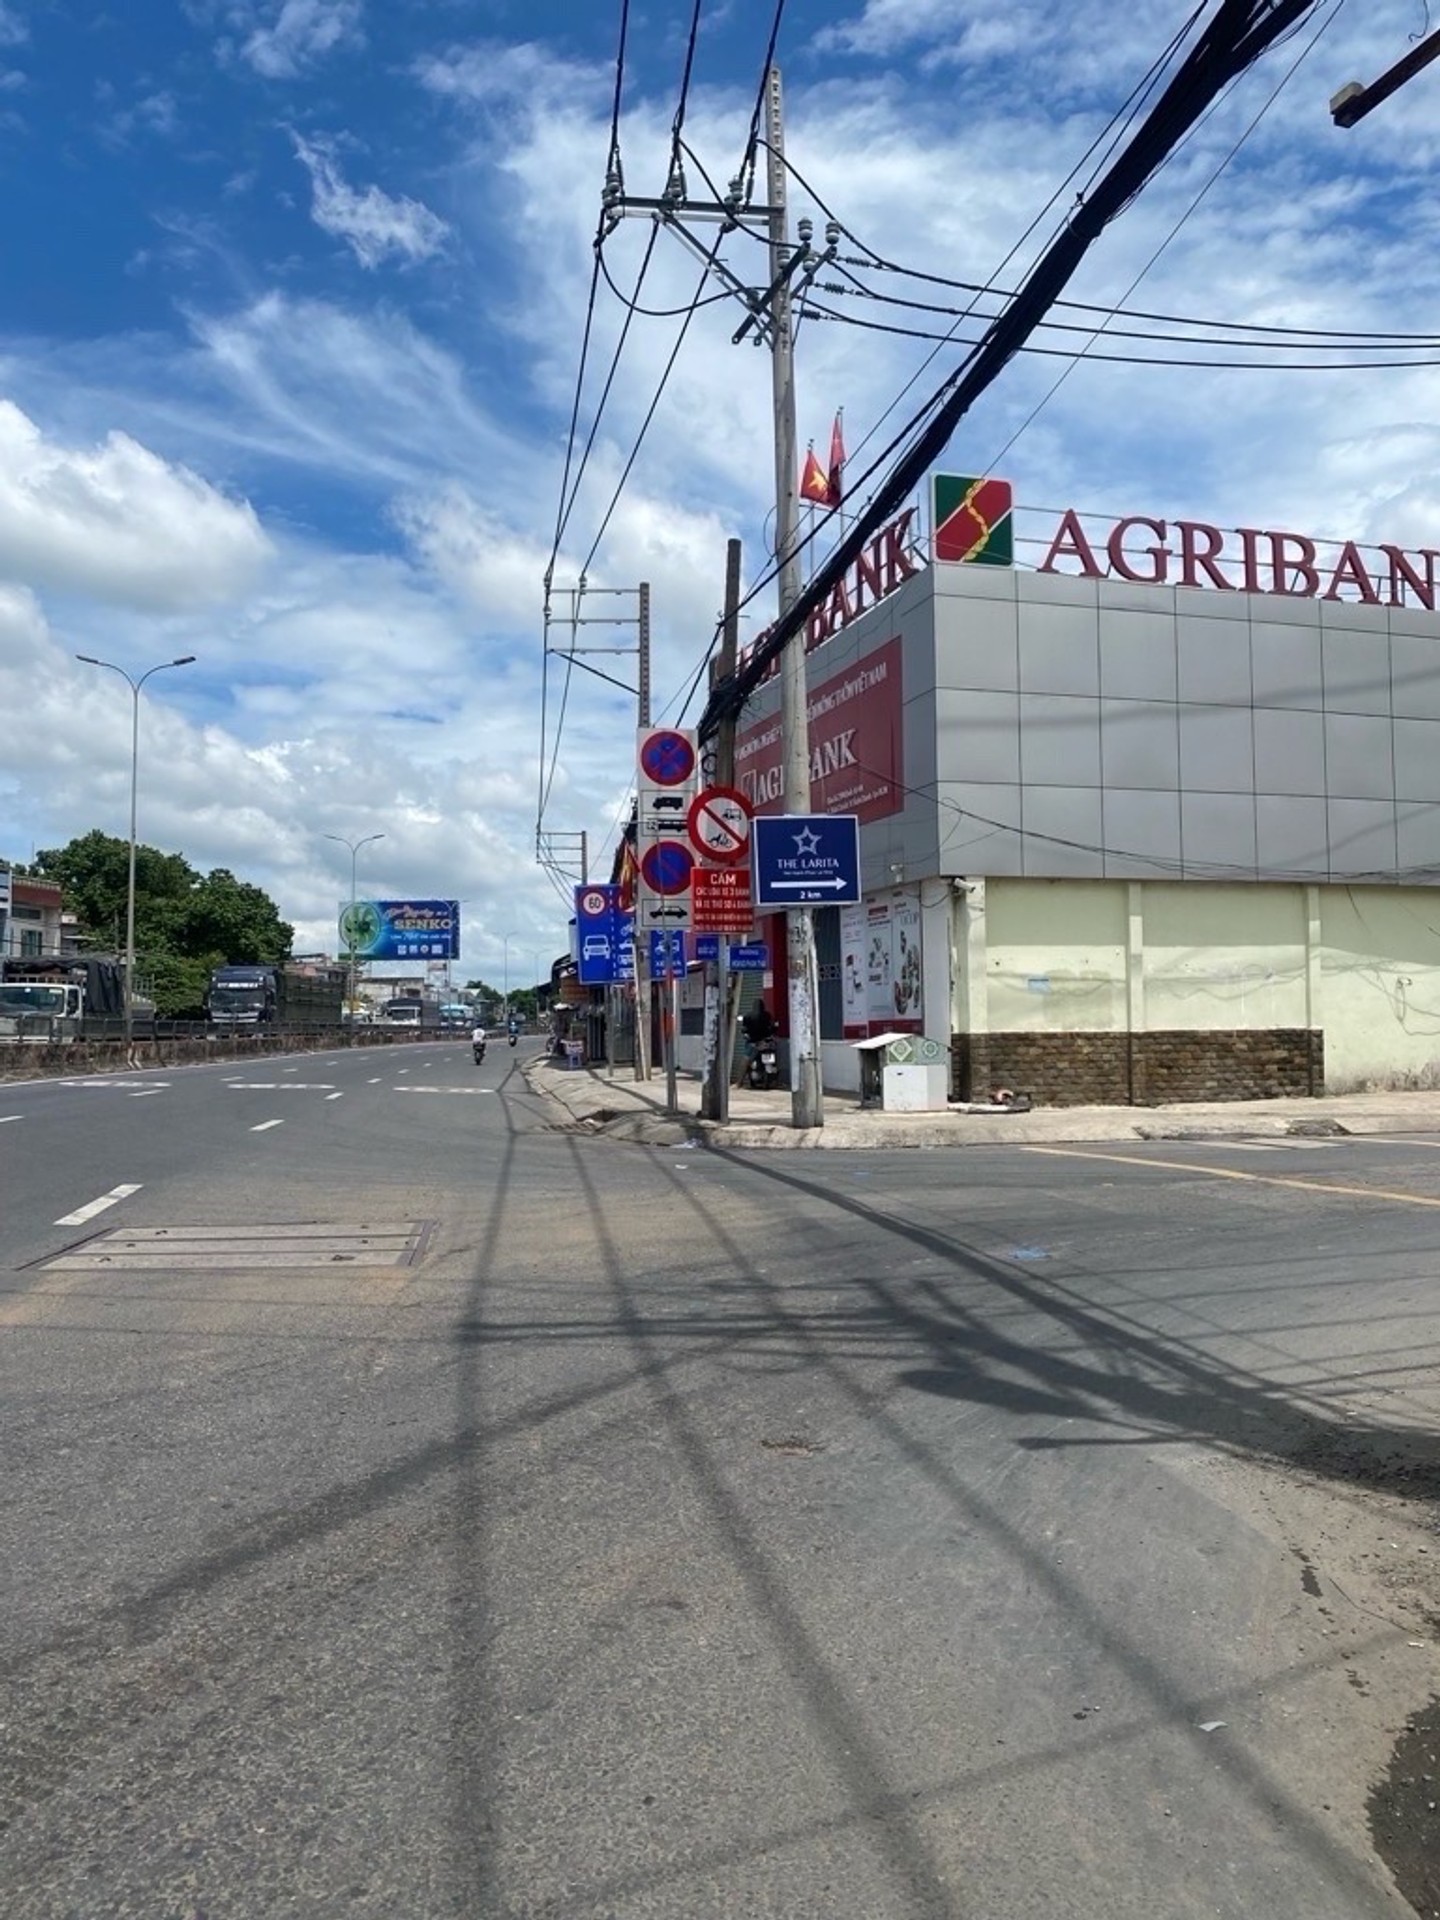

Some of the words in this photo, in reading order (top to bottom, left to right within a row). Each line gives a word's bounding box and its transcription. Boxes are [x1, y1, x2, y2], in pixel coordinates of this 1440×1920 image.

[1036, 508, 1440, 610] AGRIBAN
[777, 858, 798, 869] THE
[801, 857, 839, 869] LARITA
[710, 870, 737, 885] CẤM
[800, 890, 806, 899] 2
[807, 890, 822, 899] km
[394, 918, 453, 929] SENKO
